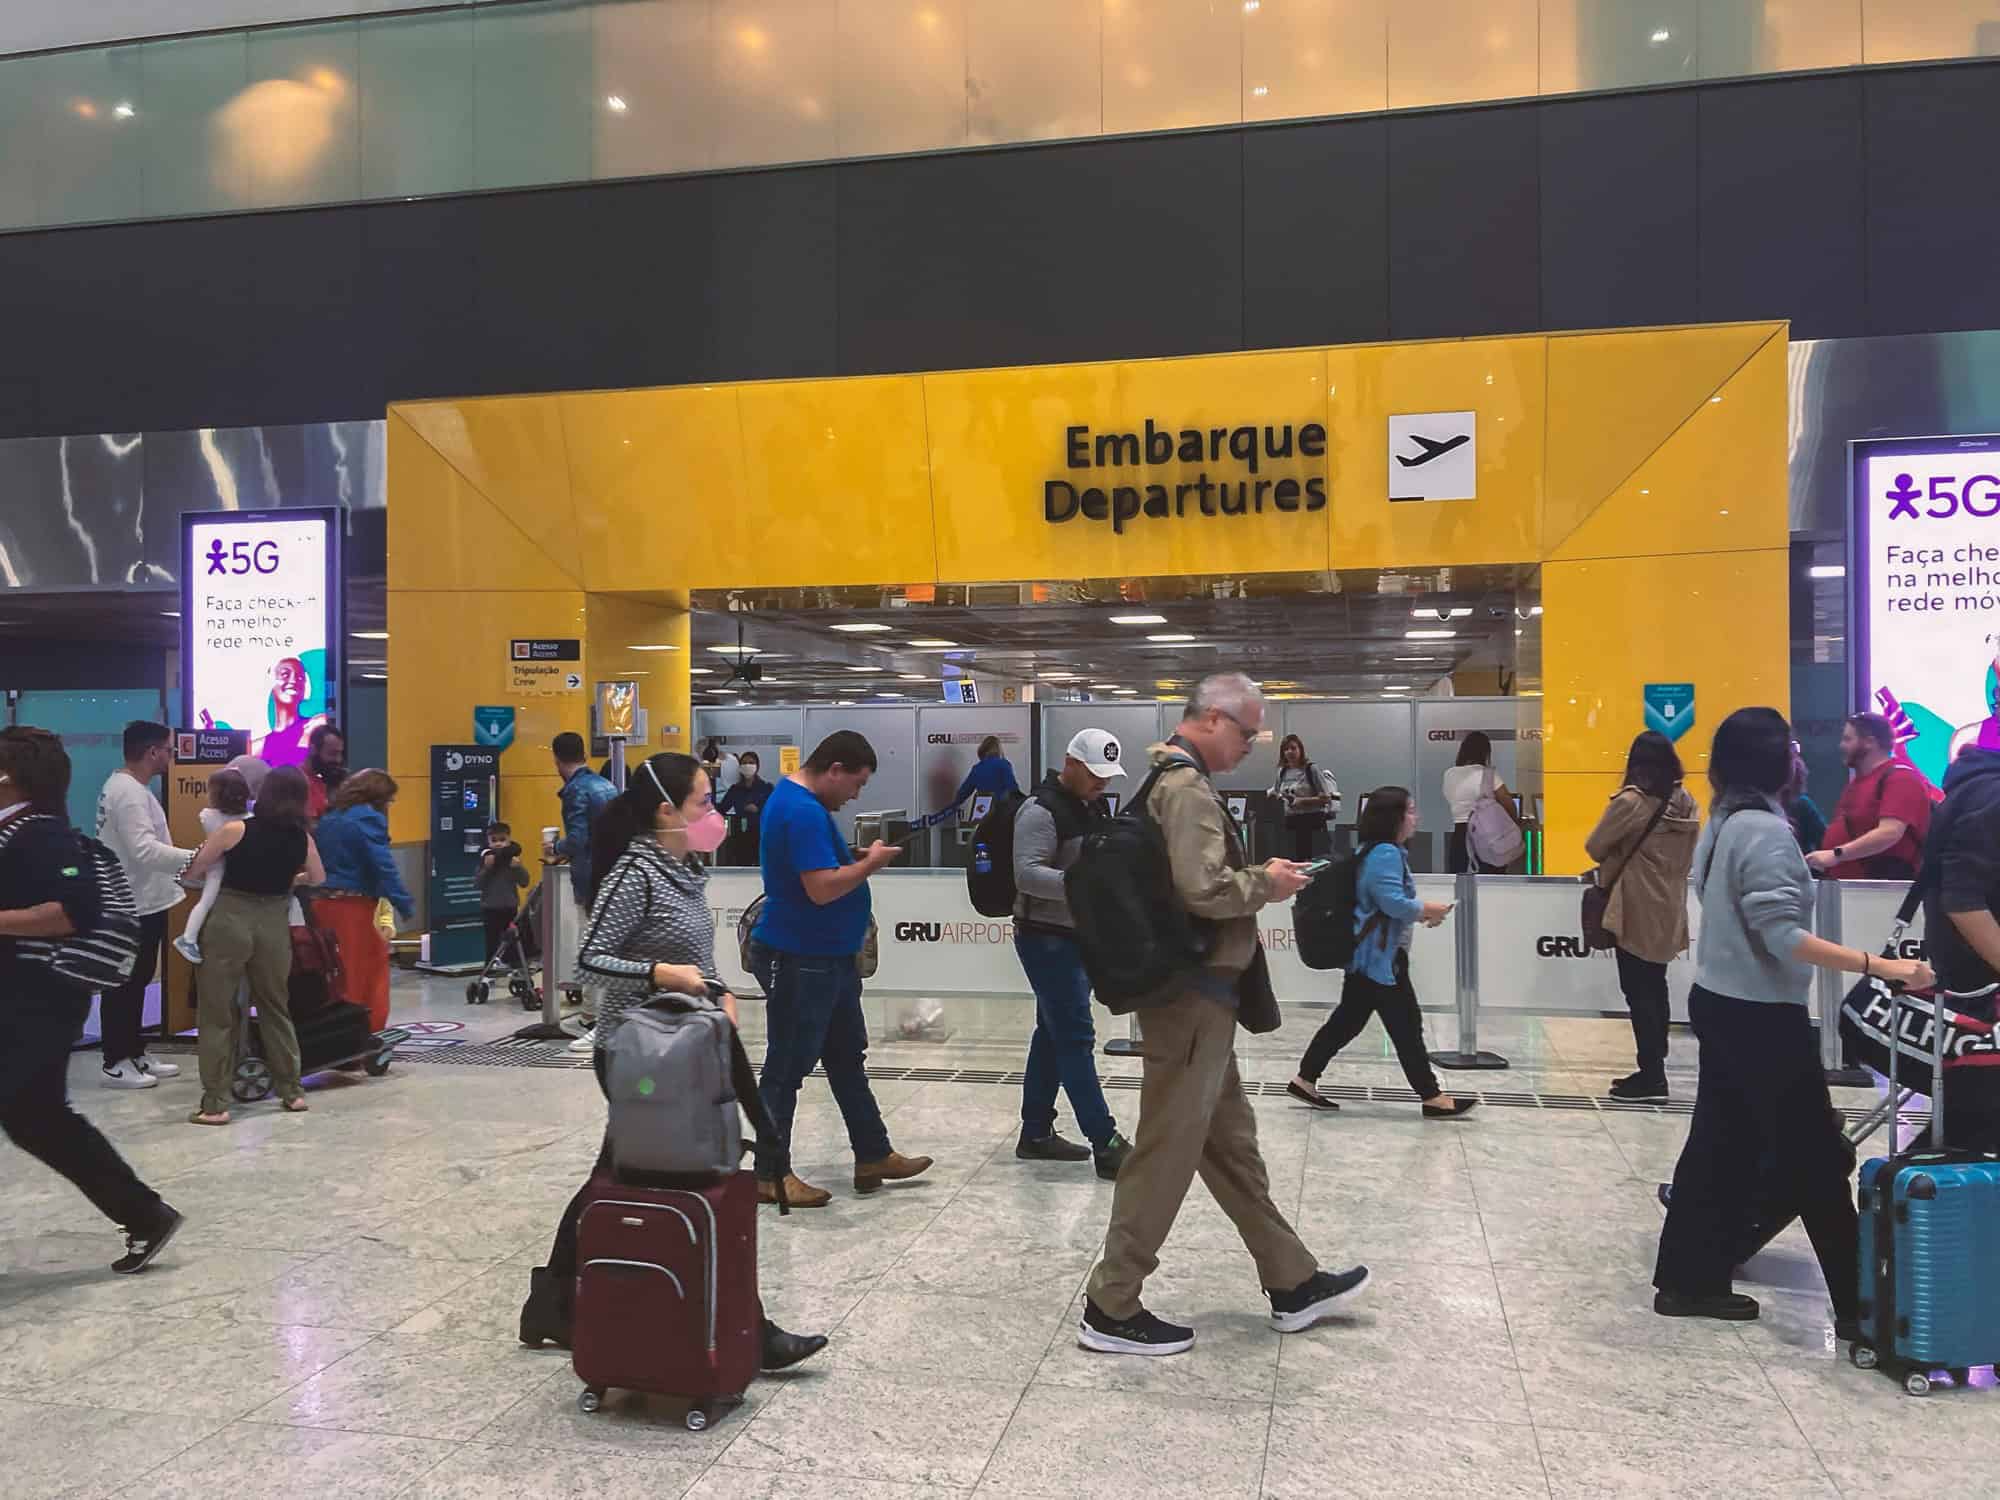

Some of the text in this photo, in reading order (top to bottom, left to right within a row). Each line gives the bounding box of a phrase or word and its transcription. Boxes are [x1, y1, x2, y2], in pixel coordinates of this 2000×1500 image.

[1067, 419, 1326, 474] Embarque
[1045, 473, 1326, 535] Departures
[1926, 474, 2000, 519] 5G
[231, 541, 280, 575] 5G
[1887, 545, 1944, 568] Faça
[1888, 573, 1917, 588] na
[1888, 592, 1945, 611] rede
